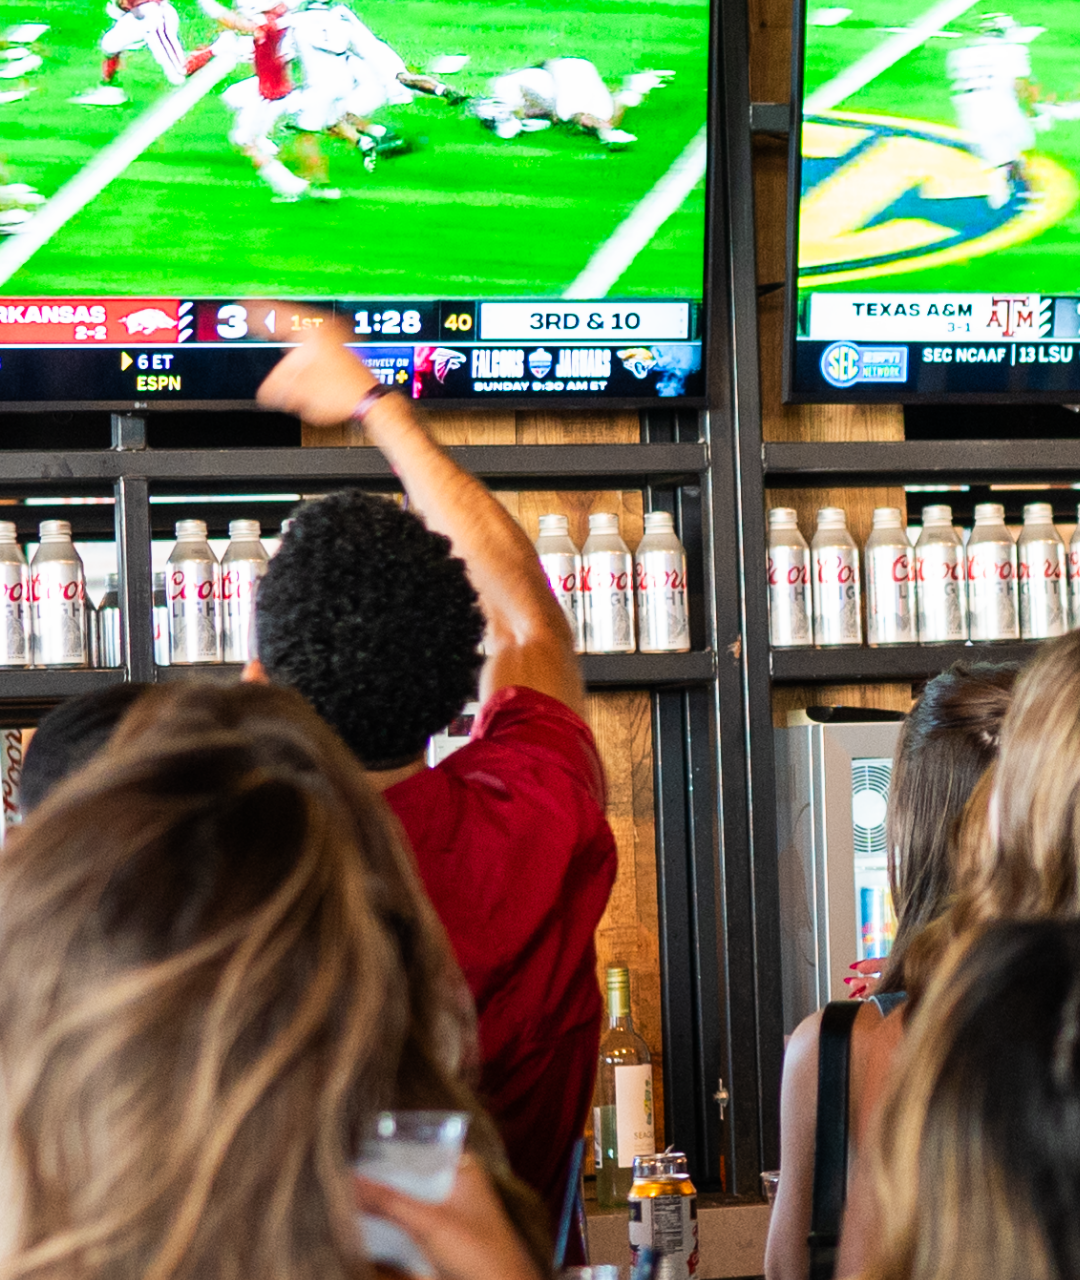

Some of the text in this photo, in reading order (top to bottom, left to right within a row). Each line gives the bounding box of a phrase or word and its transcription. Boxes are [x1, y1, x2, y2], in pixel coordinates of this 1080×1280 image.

[852, 302, 973, 317] TEXAS A&M
[216, 304, 249, 340] 3
[354, 309, 422, 335] 1:28
[444, 313, 473, 332] 40
[530, 312, 641, 331] 3RD & 10
[74, 325, 106, 340] 2-2
[137, 354, 174, 370] 6 ET
[922, 347, 953, 363] SEC
[955, 347, 1007, 363] NCAAF
[1018, 347, 1036, 363] 13
[1038, 346, 1073, 363] LSU
[136, 375, 182, 391] ESPN
[474, 381, 530, 391] SUNDAY
[567, 381, 588, 391] AM
